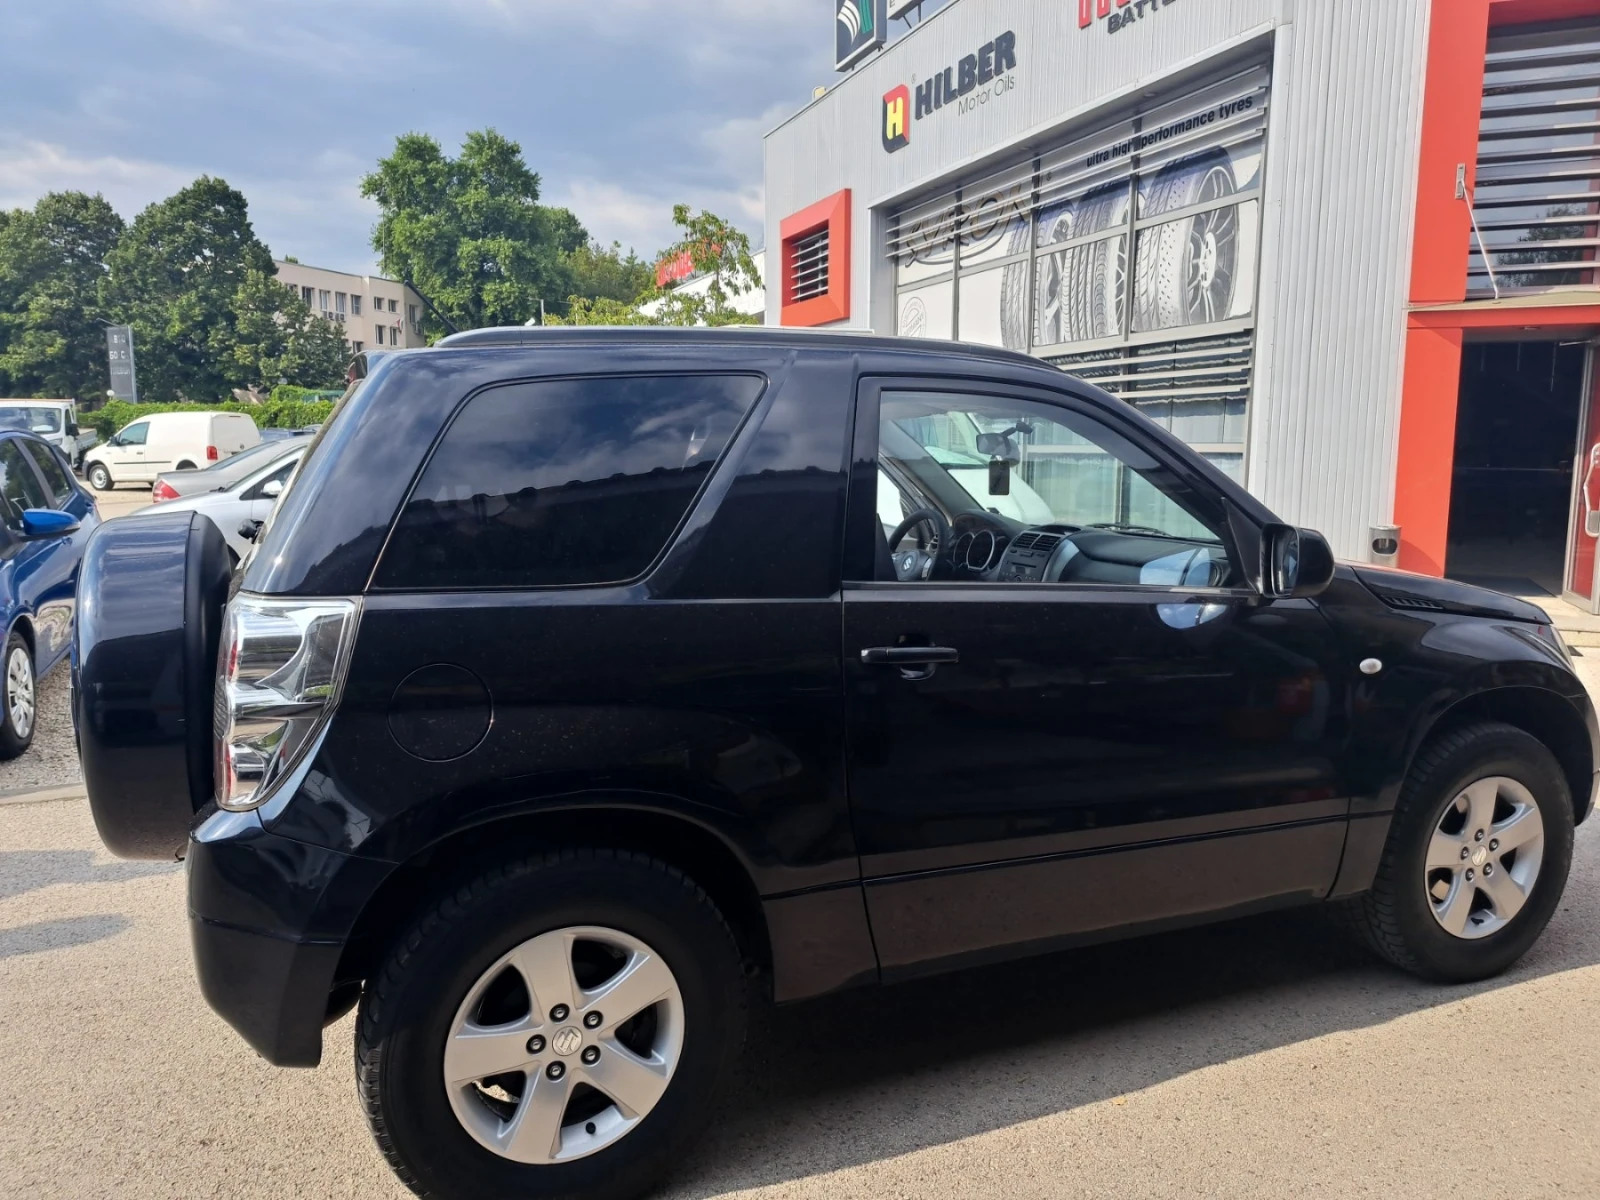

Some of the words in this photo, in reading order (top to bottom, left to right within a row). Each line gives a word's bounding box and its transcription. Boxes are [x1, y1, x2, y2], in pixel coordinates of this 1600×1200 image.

[1107, 0, 1177, 34] BATT
[915, 30, 1016, 121] HILBER
[958, 88, 991, 116] Motor
[994, 75, 1015, 97] Oils
[1086, 149, 1110, 168] ultra
[1141, 110, 1215, 149] performance
[1219, 96, 1253, 119] tyres
